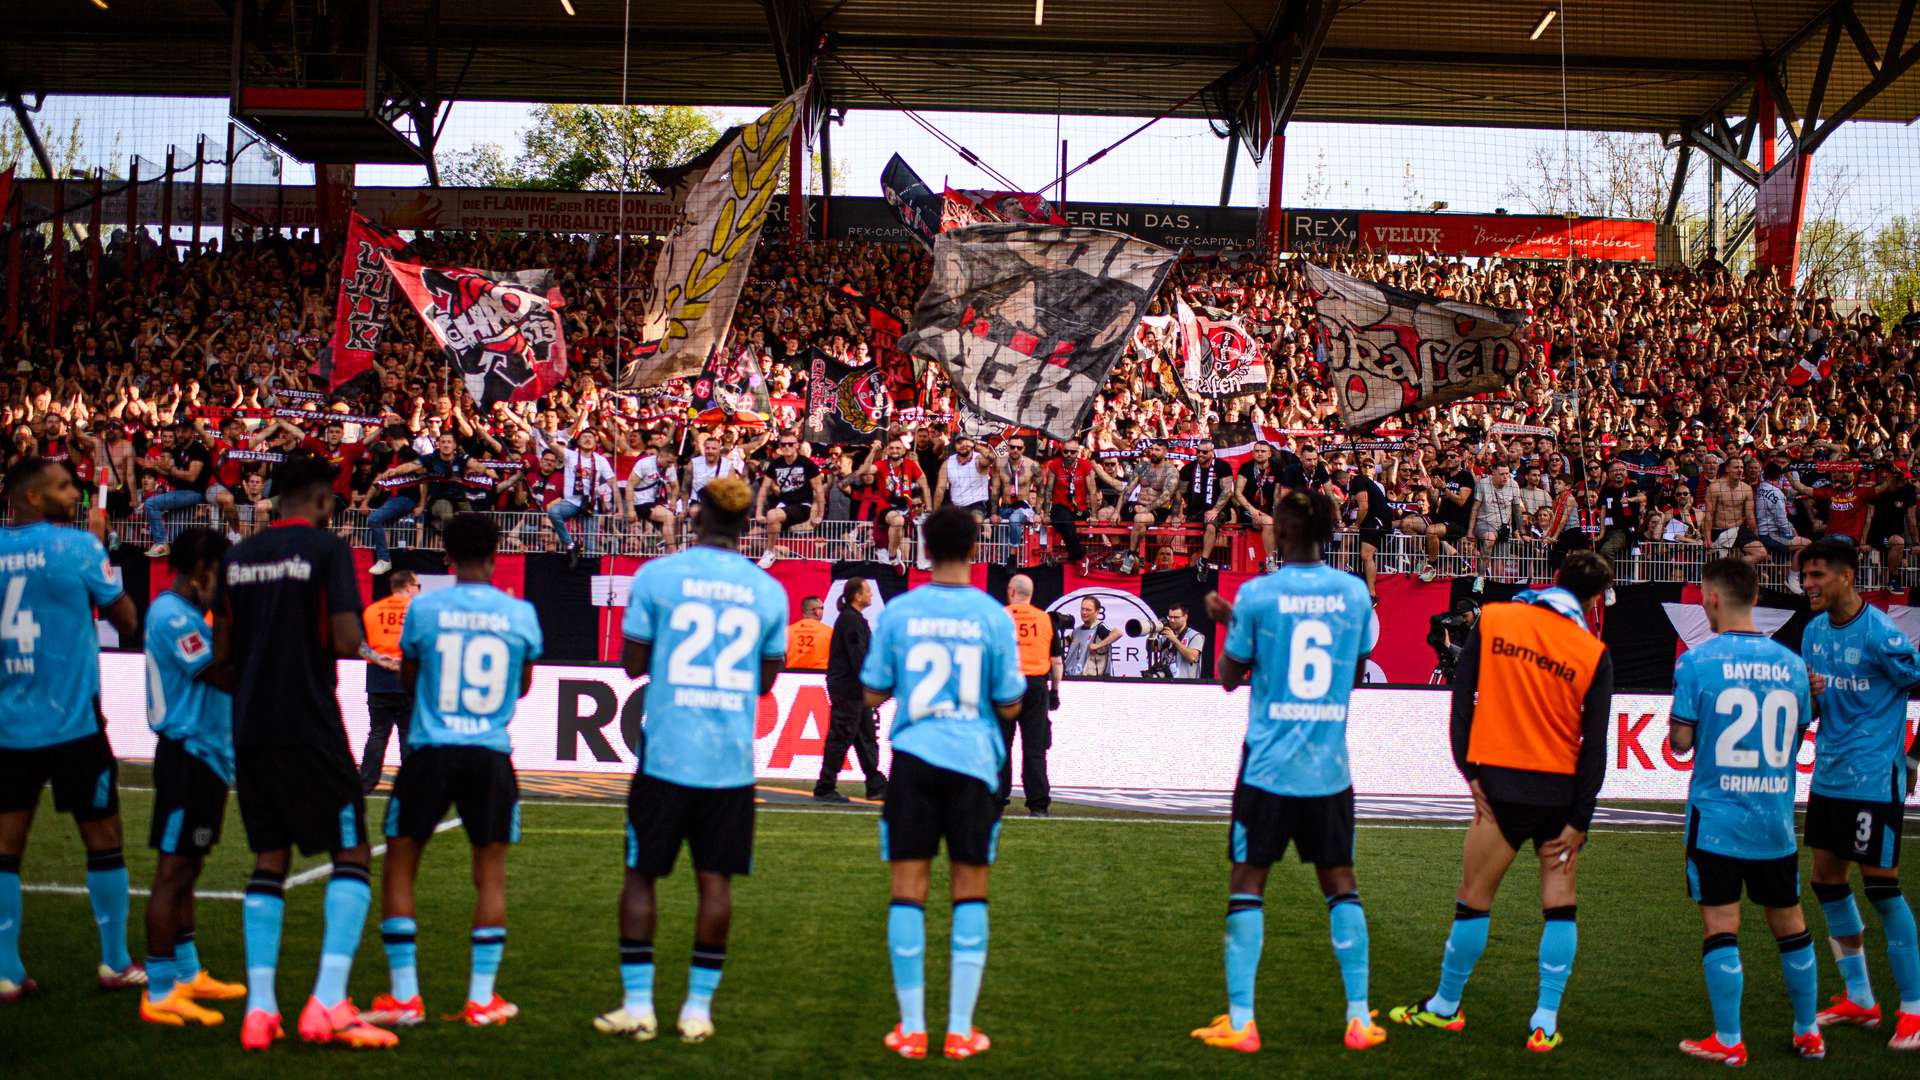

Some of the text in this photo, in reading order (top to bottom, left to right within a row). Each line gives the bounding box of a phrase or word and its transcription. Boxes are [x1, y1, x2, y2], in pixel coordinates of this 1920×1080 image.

[463, 201, 480, 210] DIE
[483, 196, 556, 212] FLAMME
[559, 203, 581, 213] DER
[584, 199, 646, 214] REGON
[651, 203, 671, 214] FÜR
[1145, 214, 1200, 229] DAS.
[1295, 216, 1347, 236] REX
[1374, 227, 1441, 243] VELUX
[1475, 227, 1522, 251] Bringt
[1527, 227, 1562, 247] Licht
[1591, 235, 1641, 249] Leben
[1, 576, 41, 653] 4
[378, 612, 407, 626] 185
[797, 635, 814, 647] 32
[1019, 623, 1038, 638] 51
[668, 602, 761, 691] 22
[5, 658, 35, 675] TAH
[1288, 619, 1333, 700] 6
[1491, 636, 1576, 683] Barmenia
[436, 633, 511, 715] 19
[906, 641, 982, 722] 21
[1715, 688, 1798, 768] 20
[1856, 811, 1872, 842] 3
